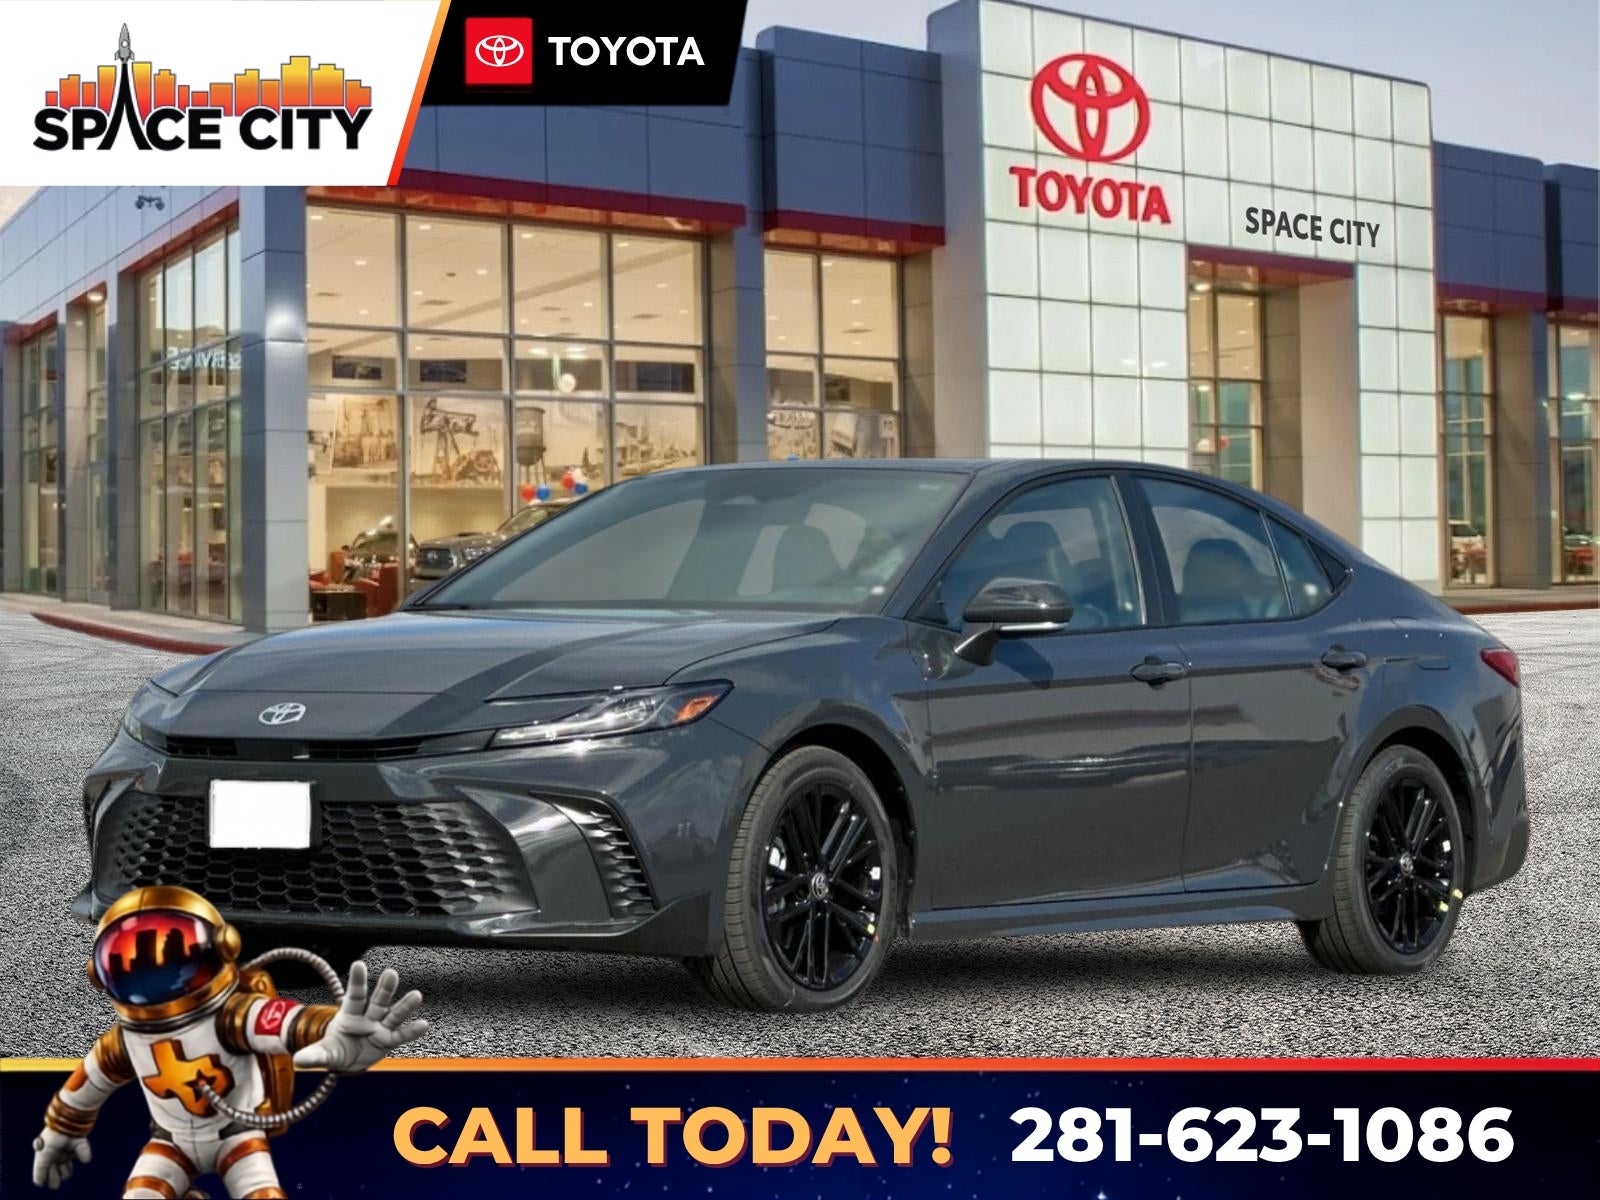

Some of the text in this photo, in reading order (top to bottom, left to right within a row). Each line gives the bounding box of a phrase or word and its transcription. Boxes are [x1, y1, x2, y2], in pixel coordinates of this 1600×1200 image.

[1009, 166, 1171, 225] TOYOTA
[1245, 206, 1380, 248] SPACE CITY
